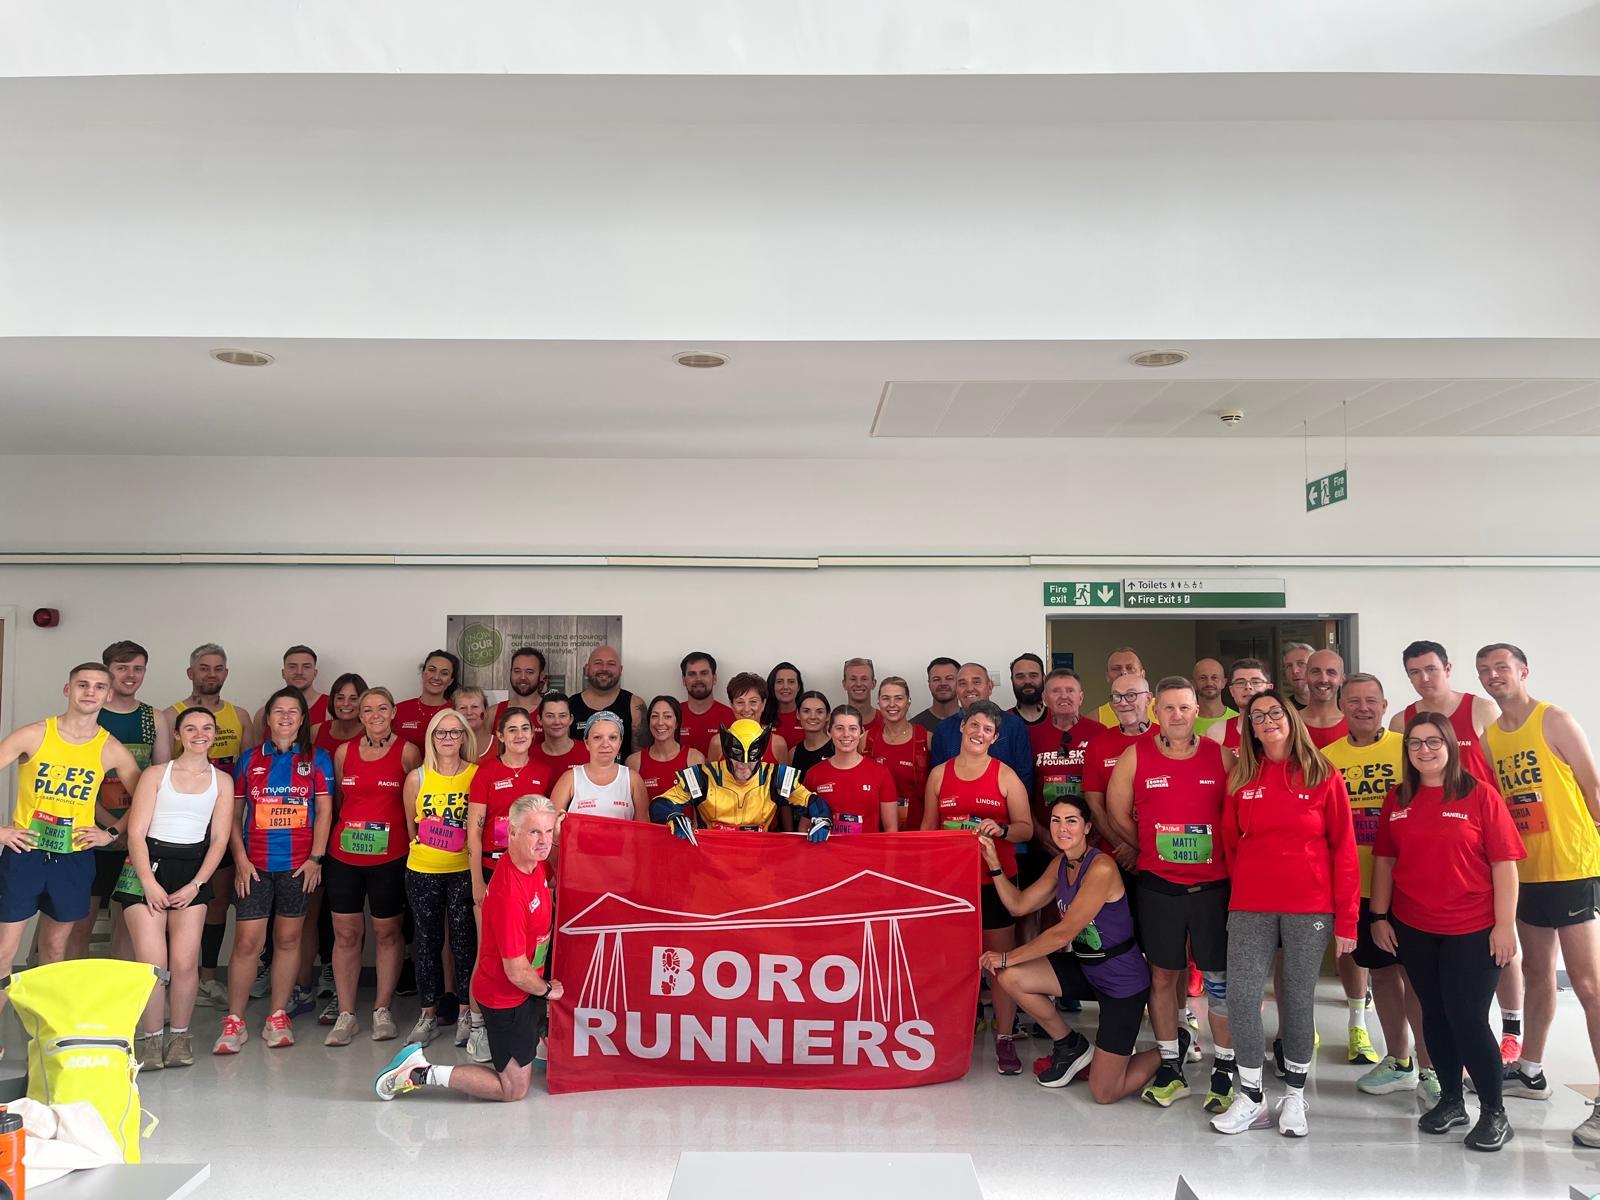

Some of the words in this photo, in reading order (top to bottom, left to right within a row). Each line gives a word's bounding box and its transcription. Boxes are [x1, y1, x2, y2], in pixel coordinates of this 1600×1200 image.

[1333, 476, 1345, 486] Fire
[1334, 487, 1345, 498] exit
[1049, 585, 1067, 594] Fire
[1138, 581, 1167, 589] Toilets
[1050, 595, 1067, 603] exit
[1138, 595, 1155, 604] Fire
[1158, 595, 1175, 604] Exit
[537, 632, 553, 642] help
[570, 634, 607, 642] encourage
[468, 639, 493, 652] YOUR
[38, 762, 96, 784] ZOE'S
[1501, 767, 1543, 791] PLACE
[35, 779, 92, 801] PLACE
[262, 786, 309, 796] myenergi
[1056, 786, 1077, 795] BRYAN
[1346, 779, 1396, 796] LACE
[975, 798, 1001, 807] LINDSEY
[270, 807, 298, 816] PETERA
[1442, 811, 1468, 820] DANIELLE
[44, 826, 66, 839] CHRIS
[430, 826, 455, 838] MARION
[834, 824, 851, 833] MONE
[352, 831, 375, 842] RACHEL
[40, 838, 64, 851] 34432
[352, 842, 373, 853] 25913
[1172, 838, 1198, 847] MATTY
[1173, 850, 1198, 861] 34810
[650, 945, 861, 1004] BORO
[573, 1007, 937, 1072] RUNNERS
